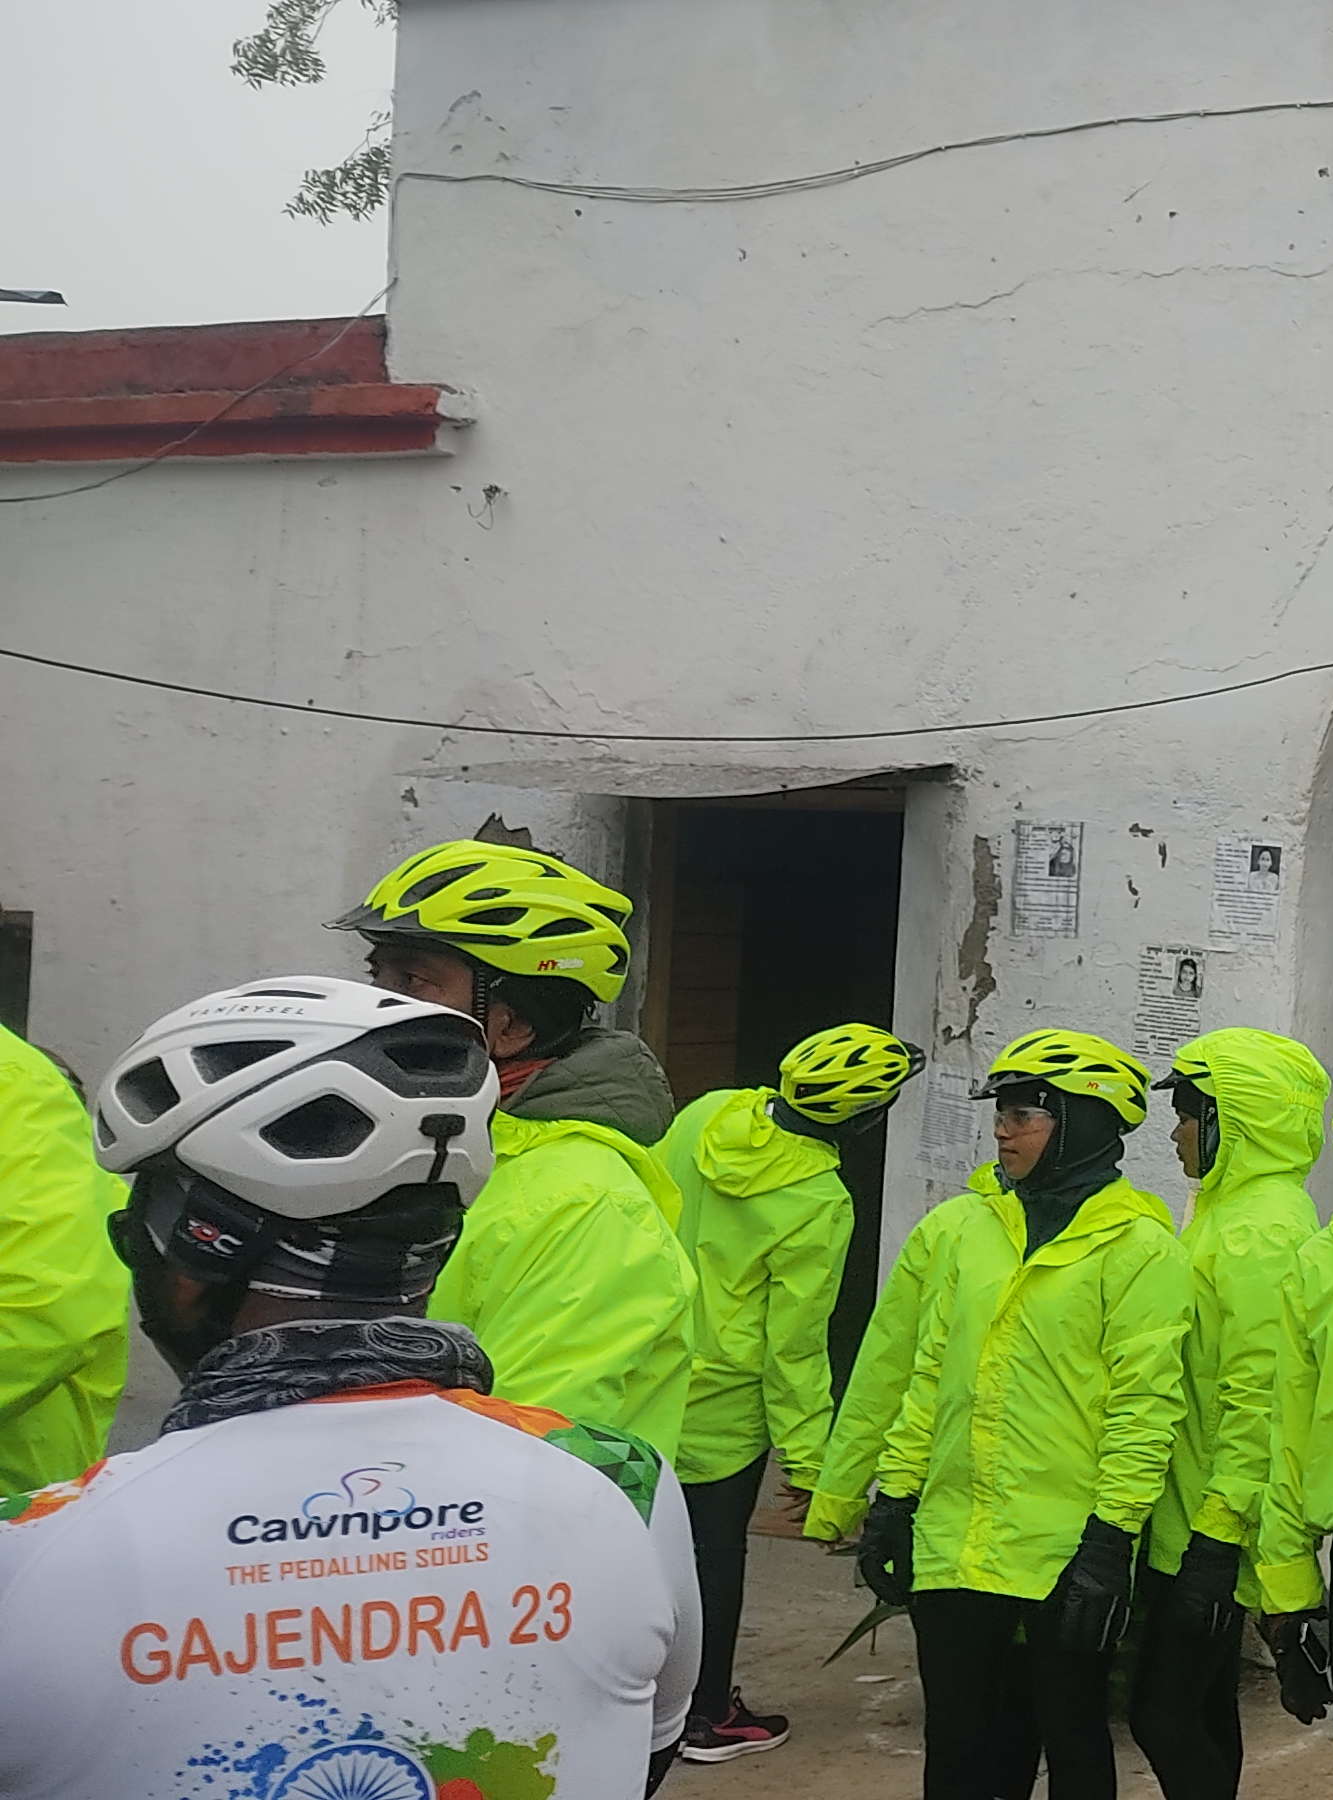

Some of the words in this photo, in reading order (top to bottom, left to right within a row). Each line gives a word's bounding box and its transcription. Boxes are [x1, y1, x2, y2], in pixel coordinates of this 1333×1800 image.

[226, 1499, 485, 1546] Cawnpore
[430, 1525, 486, 1541] riders
[225, 1563, 272, 1587] THE
[279, 1551, 407, 1582] PEDALLING
[415, 1542, 489, 1569] SOULS
[120, 1589, 491, 1685] GAJENDRA
[508, 1581, 573, 1646] 23
